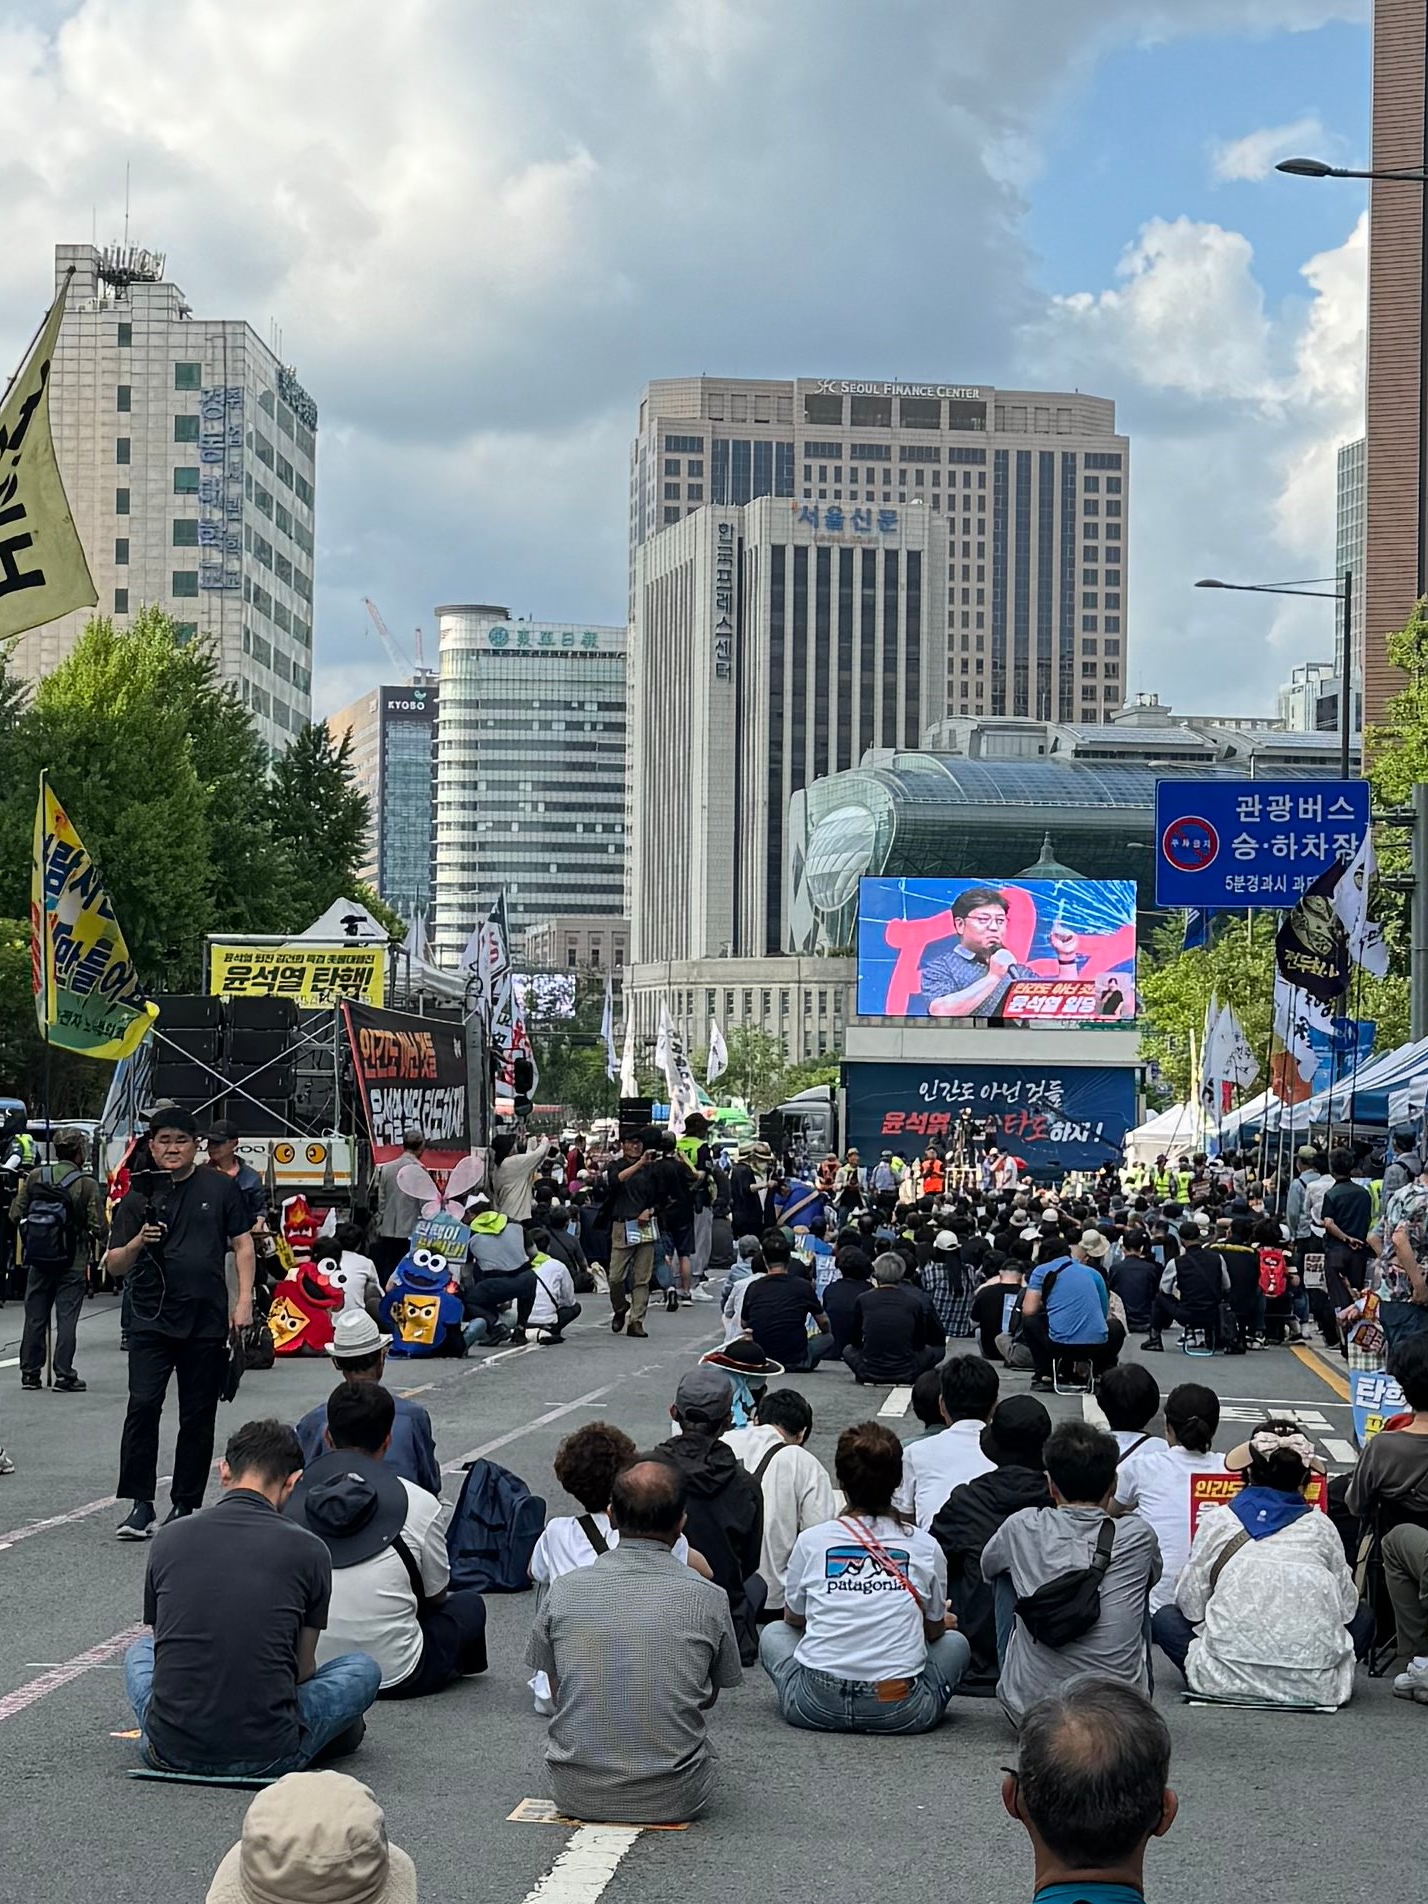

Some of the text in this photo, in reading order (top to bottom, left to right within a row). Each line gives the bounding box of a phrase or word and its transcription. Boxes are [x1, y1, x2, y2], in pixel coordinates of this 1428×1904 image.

[1235, 794, 1355, 823] 관광버스
[1231, 832, 1360, 866] 승·하차장
[1225, 874, 1287, 893] 5분경과시
[223, 966, 374, 996] 윤석열 탄핵!
[919, 1079, 1065, 1108] 인간도 아닌 것들
[881, 1112, 952, 1136] 윤석열
[826, 1578, 906, 1595] patagonia
